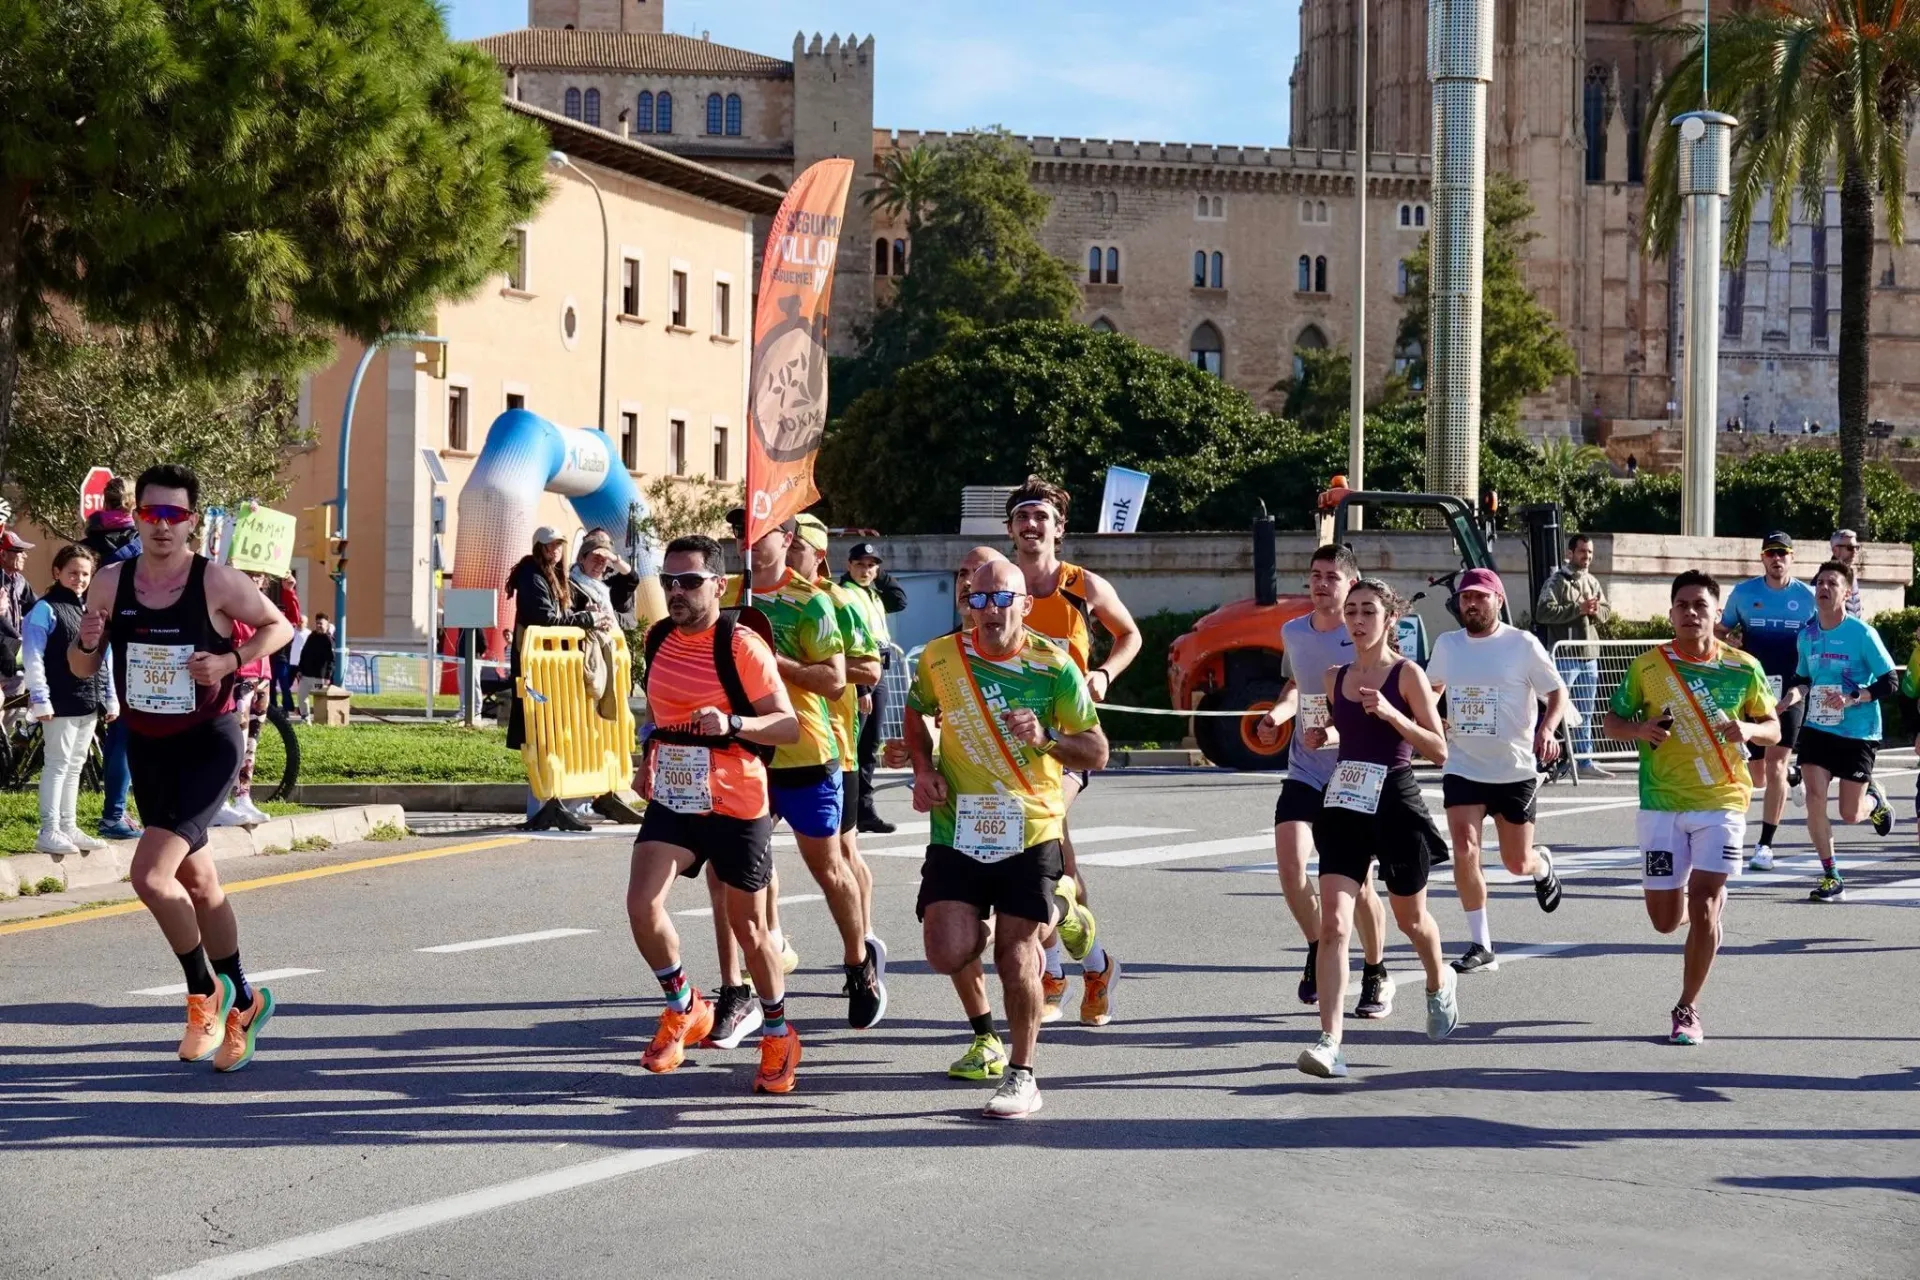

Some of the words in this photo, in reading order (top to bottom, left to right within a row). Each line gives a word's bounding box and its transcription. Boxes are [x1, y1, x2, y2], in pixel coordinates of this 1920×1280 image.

[143, 669, 177, 685] 3647
[1461, 704, 1485, 716] 4134
[664, 771, 693, 786] 5009
[1340, 769, 1367, 785] 5001
[974, 820, 1007, 835] 4662
